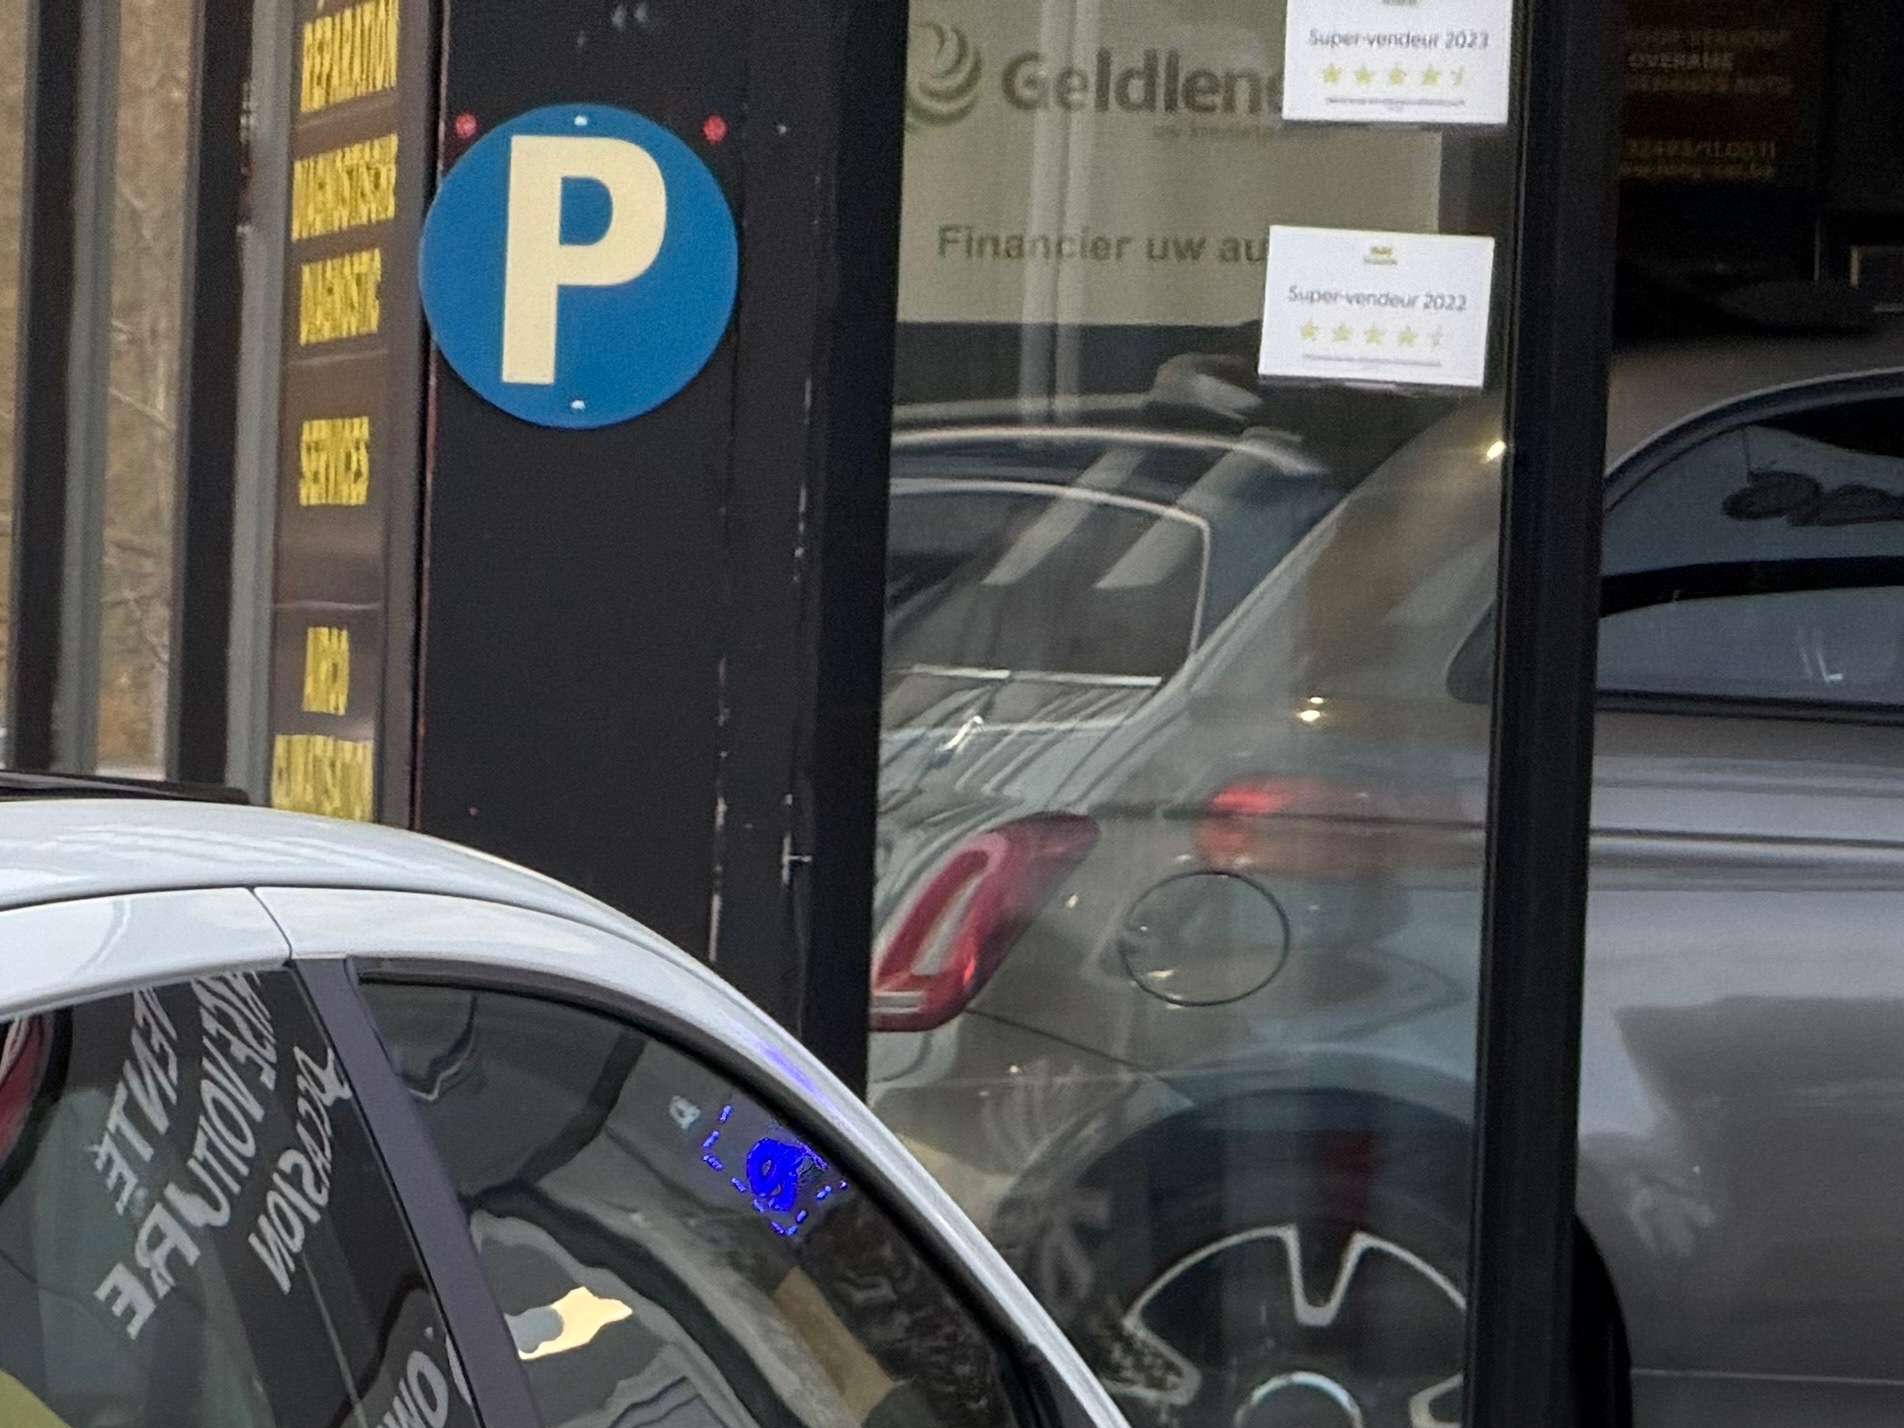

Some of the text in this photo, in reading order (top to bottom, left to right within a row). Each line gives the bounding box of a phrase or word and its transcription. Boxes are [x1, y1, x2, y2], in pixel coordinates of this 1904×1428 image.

[1002, 47, 1285, 114] Geldlen
[501, 134, 668, 386] P
[938, 225, 1267, 264] Financier uw au
[1289, 285, 1420, 309] Super-vendeur
[299, 416, 370, 506] SERVICES
